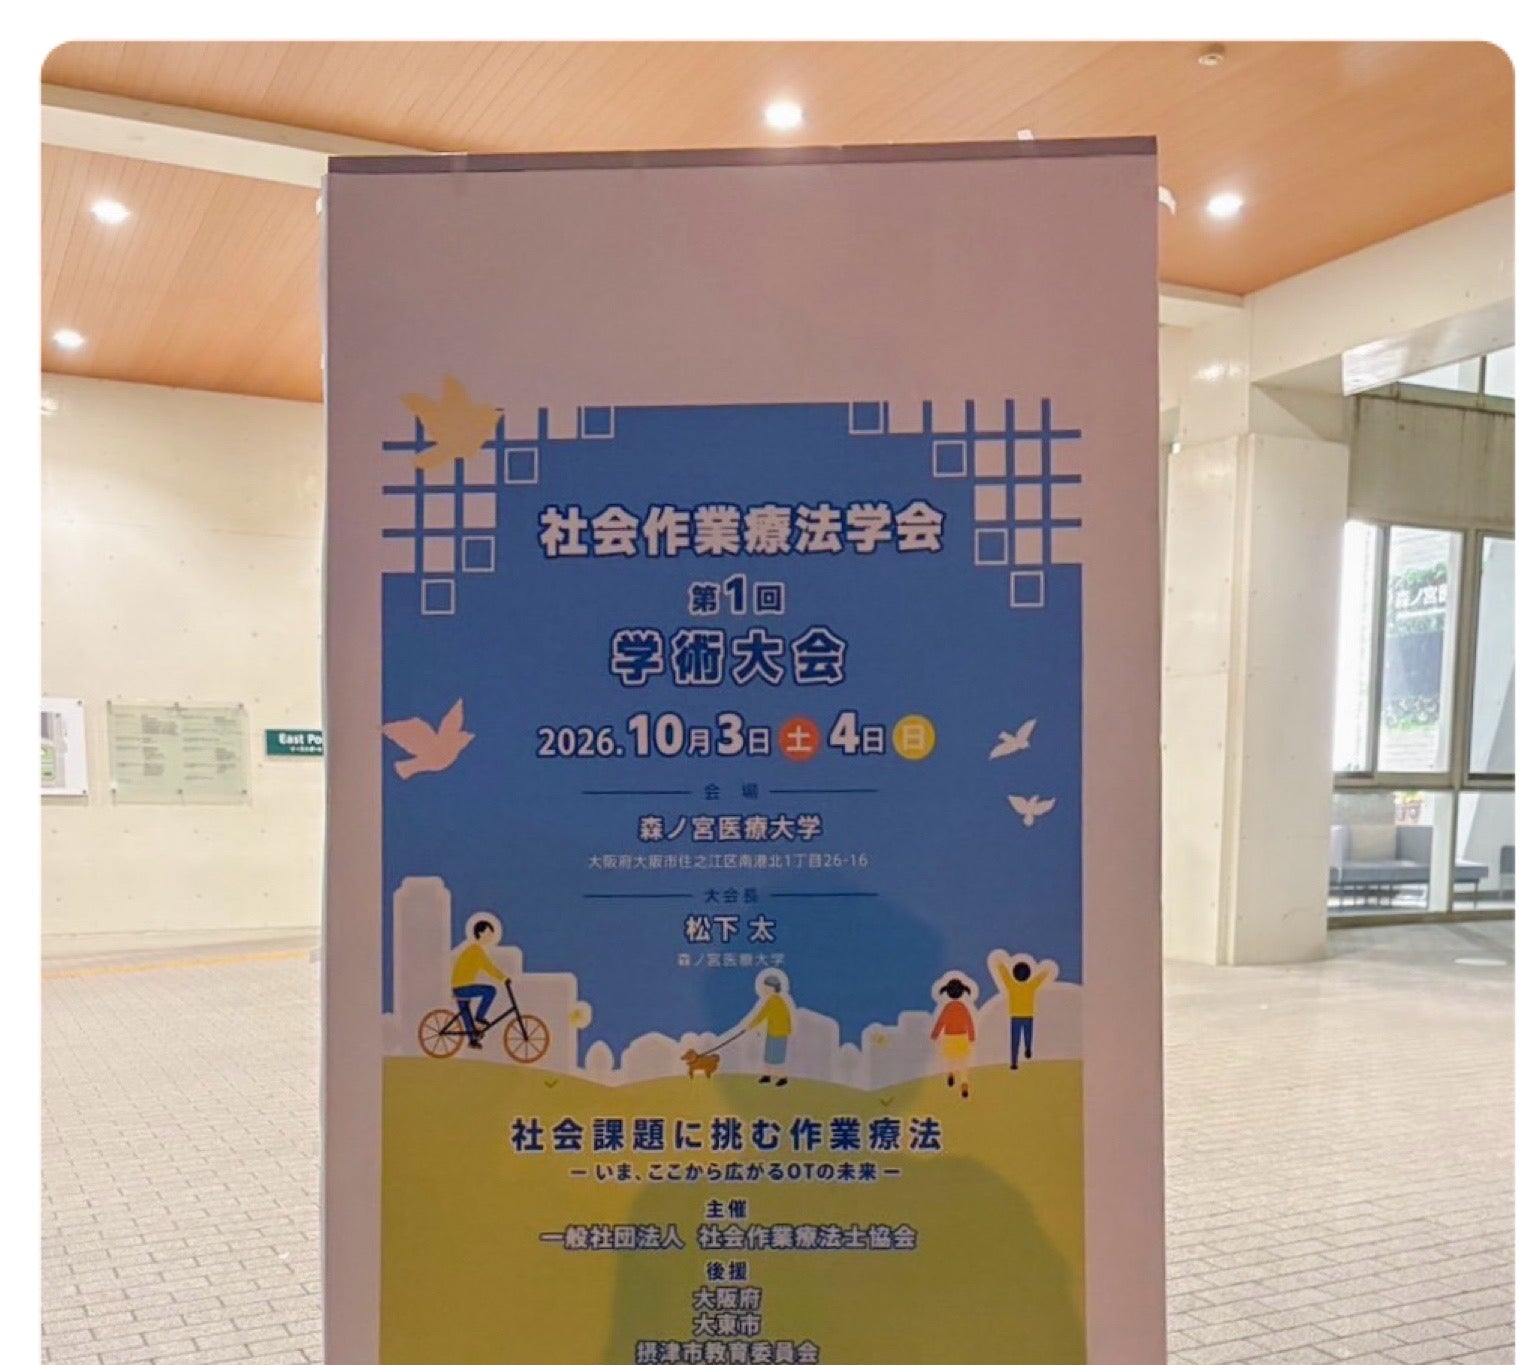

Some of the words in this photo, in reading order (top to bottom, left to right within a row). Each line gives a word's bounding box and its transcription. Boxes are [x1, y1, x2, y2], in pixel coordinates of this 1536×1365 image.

[540, 501, 945, 557] 社会作業療法学会
[688, 575, 785, 614] 第1回
[610, 627, 847, 687] 学術大会
[278, 732, 305, 745] East
[638, 814, 823, 843] 森ノ宮医療大学
[703, 886, 761, 906] 大会長
[685, 915, 740, 945] 松下
[677, 951, 786, 969] 森ノ宮医療大学
[511, 1117, 944, 1155] 社会課題に挑む作業療法
[706, 1199, 748, 1220] 主催
[540, 1225, 685, 1251] 一般社団法人
[699, 1224, 917, 1250] 社会作業療法士協会
[706, 1261, 748, 1282] 後援
[692, 1286, 762, 1312] 大阪府
[692, 1312, 762, 1338] 大東市
[635, 1340, 820, 1365] 摂津市教育委員会
